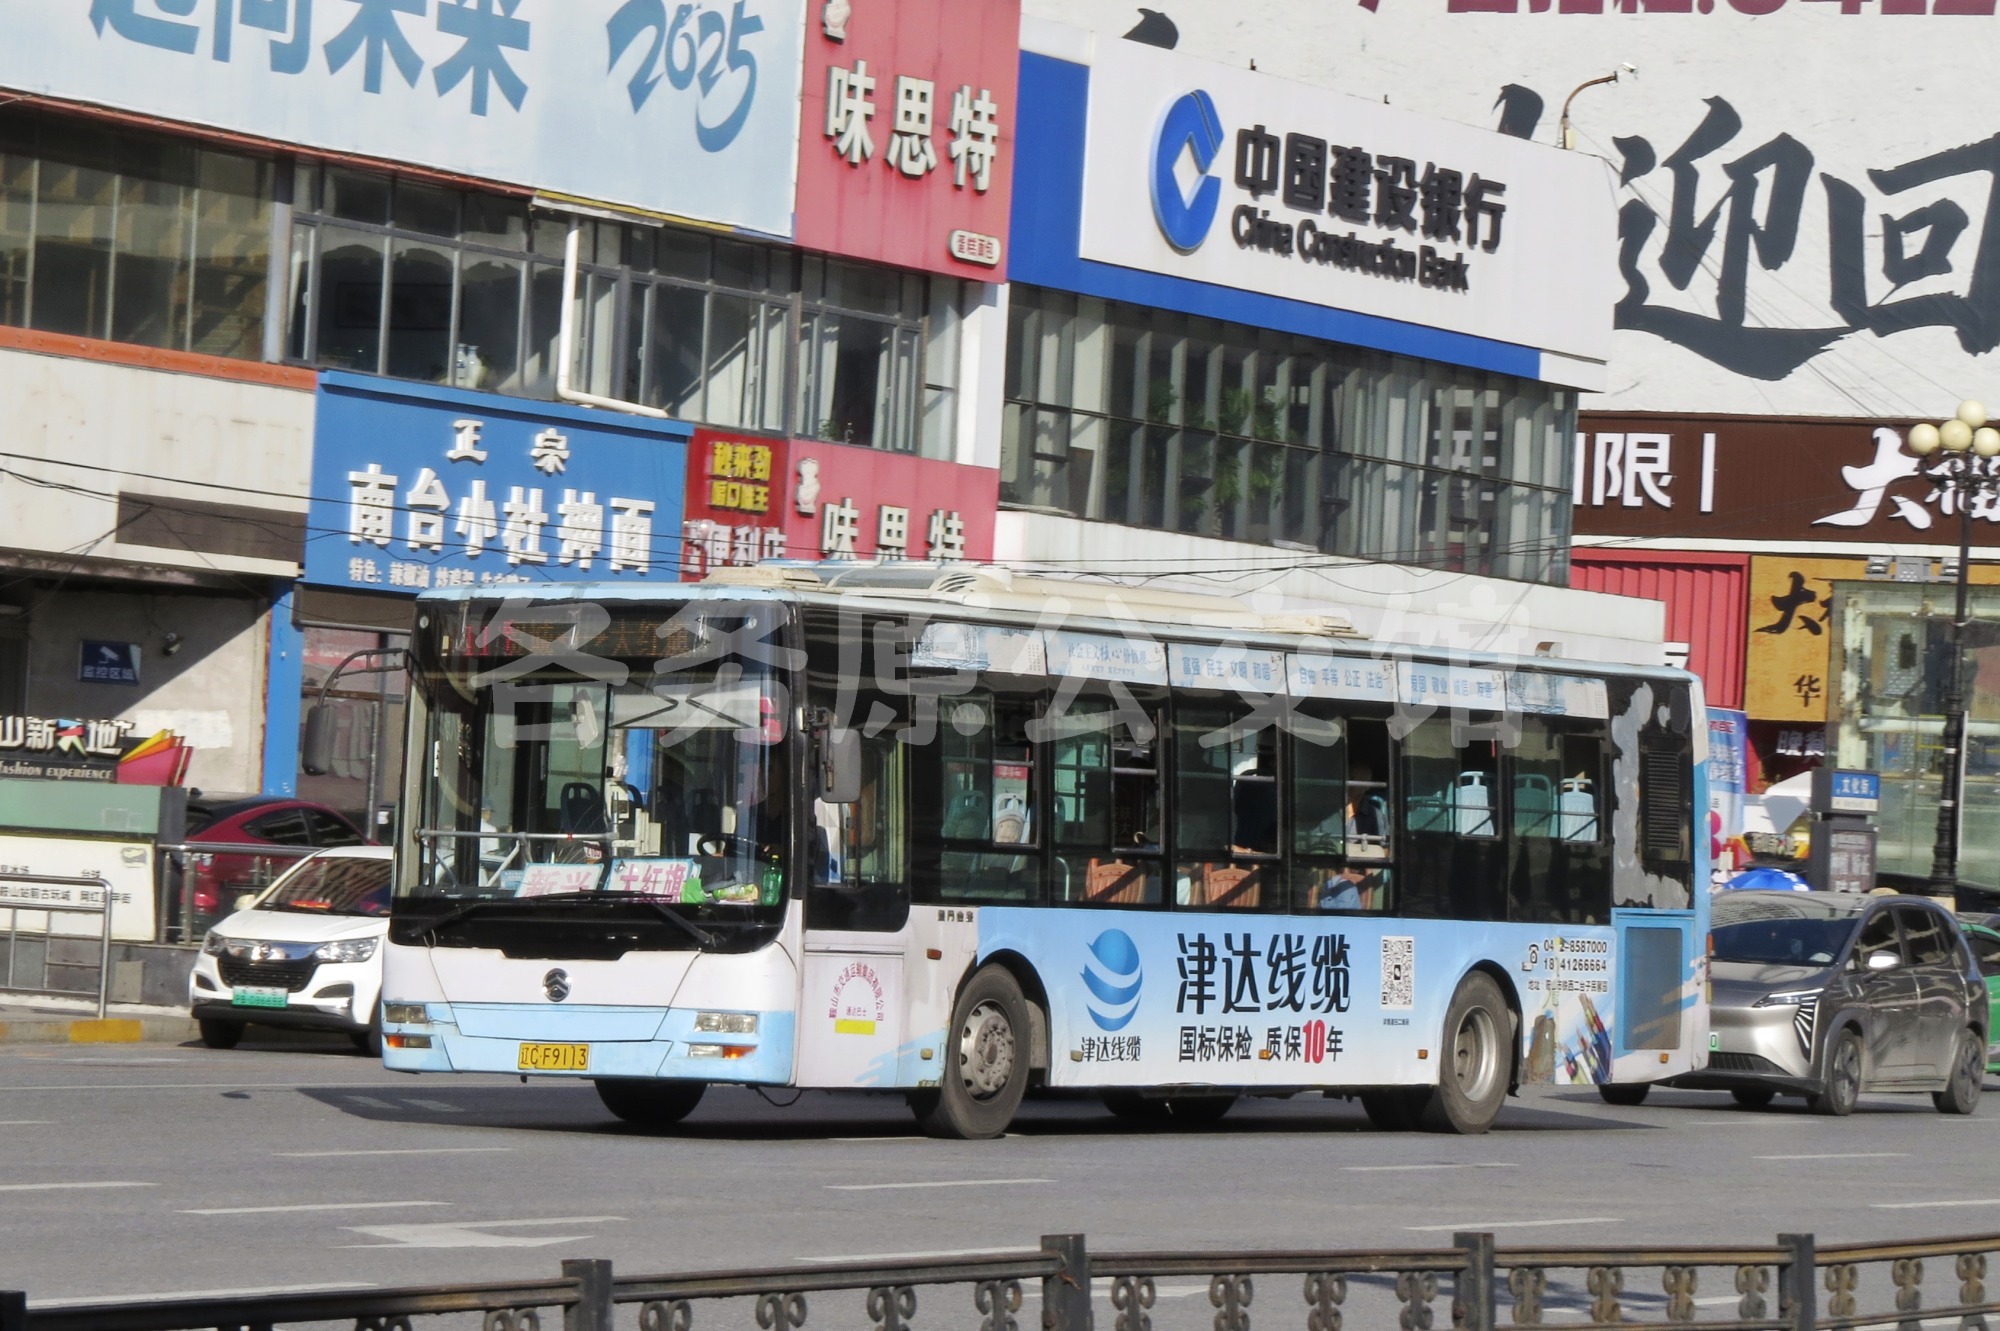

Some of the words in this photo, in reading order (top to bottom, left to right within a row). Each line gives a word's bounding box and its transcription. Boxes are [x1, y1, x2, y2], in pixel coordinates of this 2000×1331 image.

[606, 0, 765, 153] 2025
[824, 59, 1000, 192] 味思特
[1234, 124, 1507, 254] 中国建设银行
[1232, 204, 1294, 256] China
[1297, 219, 1417, 282] Construction
[1418, 244, 1471, 294] Bank
[1613, 95, 2000, 381] 迎回
[446, 418, 571, 476] 正宗
[821, 497, 966, 562] 味思特
[1752, 571, 1834, 636] 大
[1182, 656, 1201, 676] 富强
[1206, 658, 1224, 678] 民主
[1230, 660, 1247, 680] 文明
[1252, 661, 1271, 681] 和谐
[1322, 668, 1339, 686] 平等
[1344, 669, 1361, 688] 公正
[1366, 671, 1383, 689] 法治
[1793, 675, 1821, 708] 华
[619, 862, 688, 903] 大红旗
[1176, 932, 1352, 1015] 津达线缆
[1543, 938, 1608, 954] 042-8587000
[1543, 957, 1608, 972] 1841266664
[1080, 1035, 1142, 1062] 津达线缆
[1178, 1025, 1253, 1063] 国标保检
[1264, 1019, 1344, 1064] 质保10年
